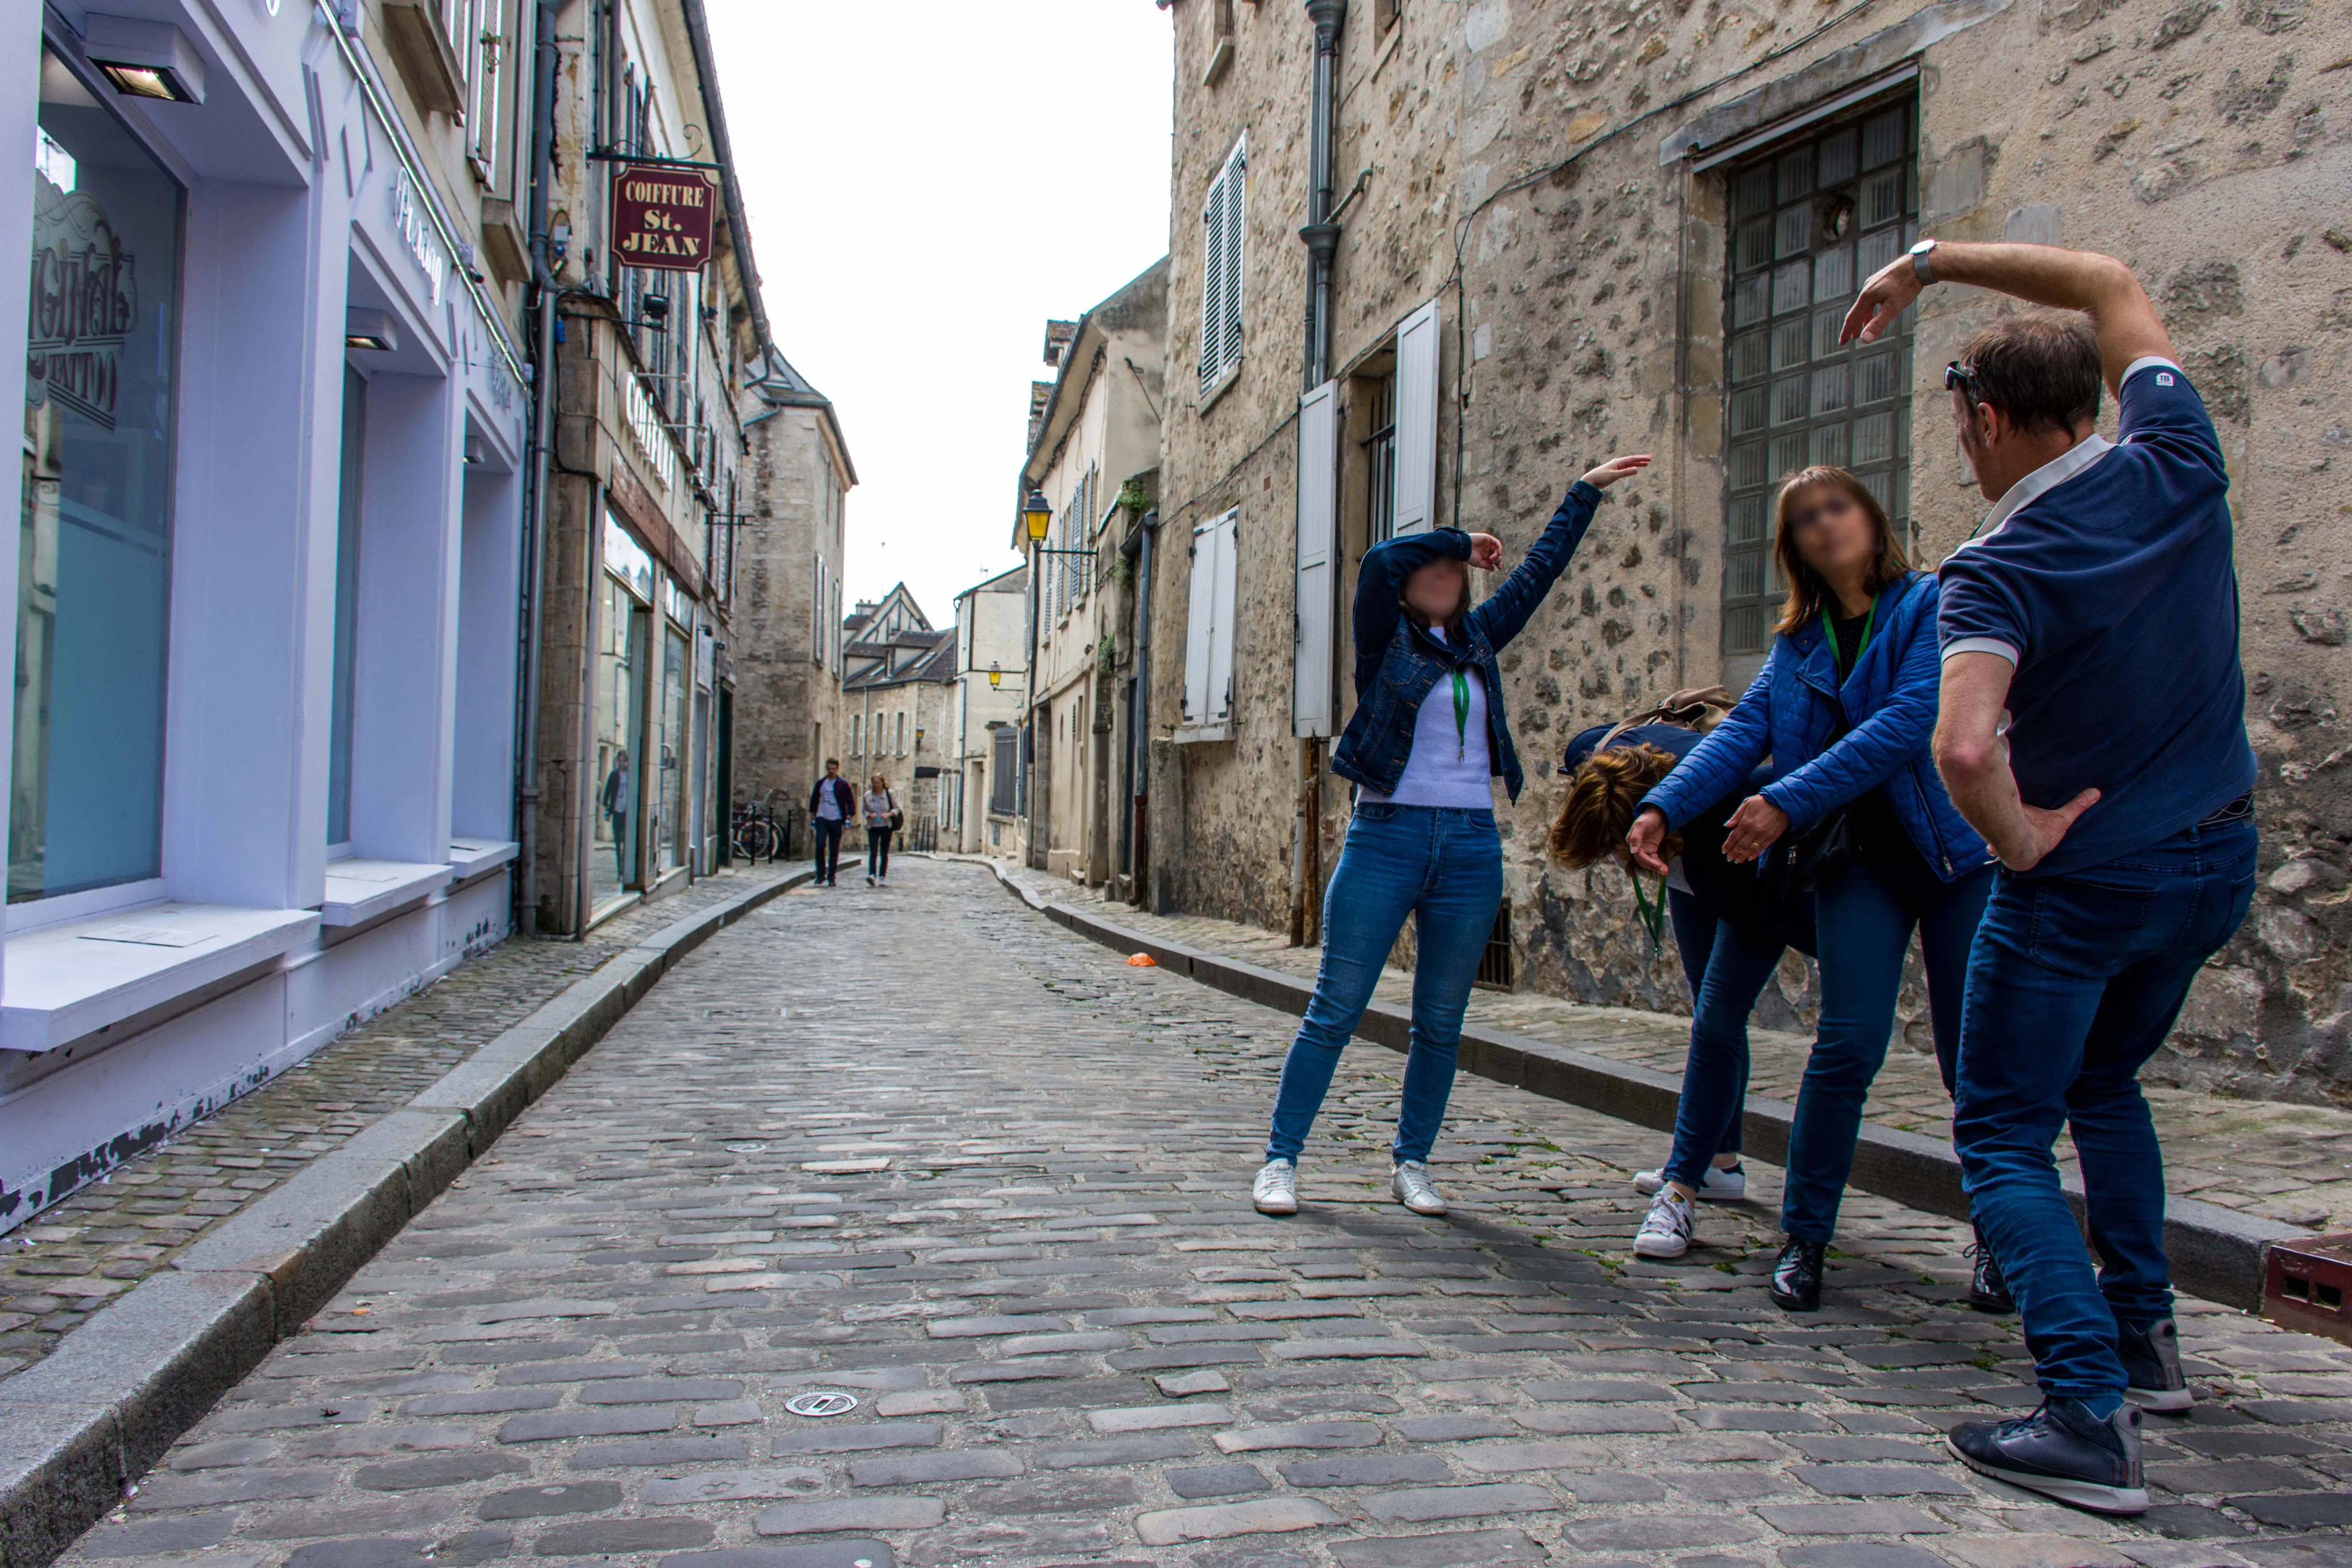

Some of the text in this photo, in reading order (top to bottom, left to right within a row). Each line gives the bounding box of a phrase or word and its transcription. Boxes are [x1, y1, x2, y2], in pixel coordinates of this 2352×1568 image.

[625, 180, 705, 208] COIFFURE
[644, 209, 683, 232] St.
[622, 232, 701, 257] JEAN
[48, 351, 117, 413] TATTOO
